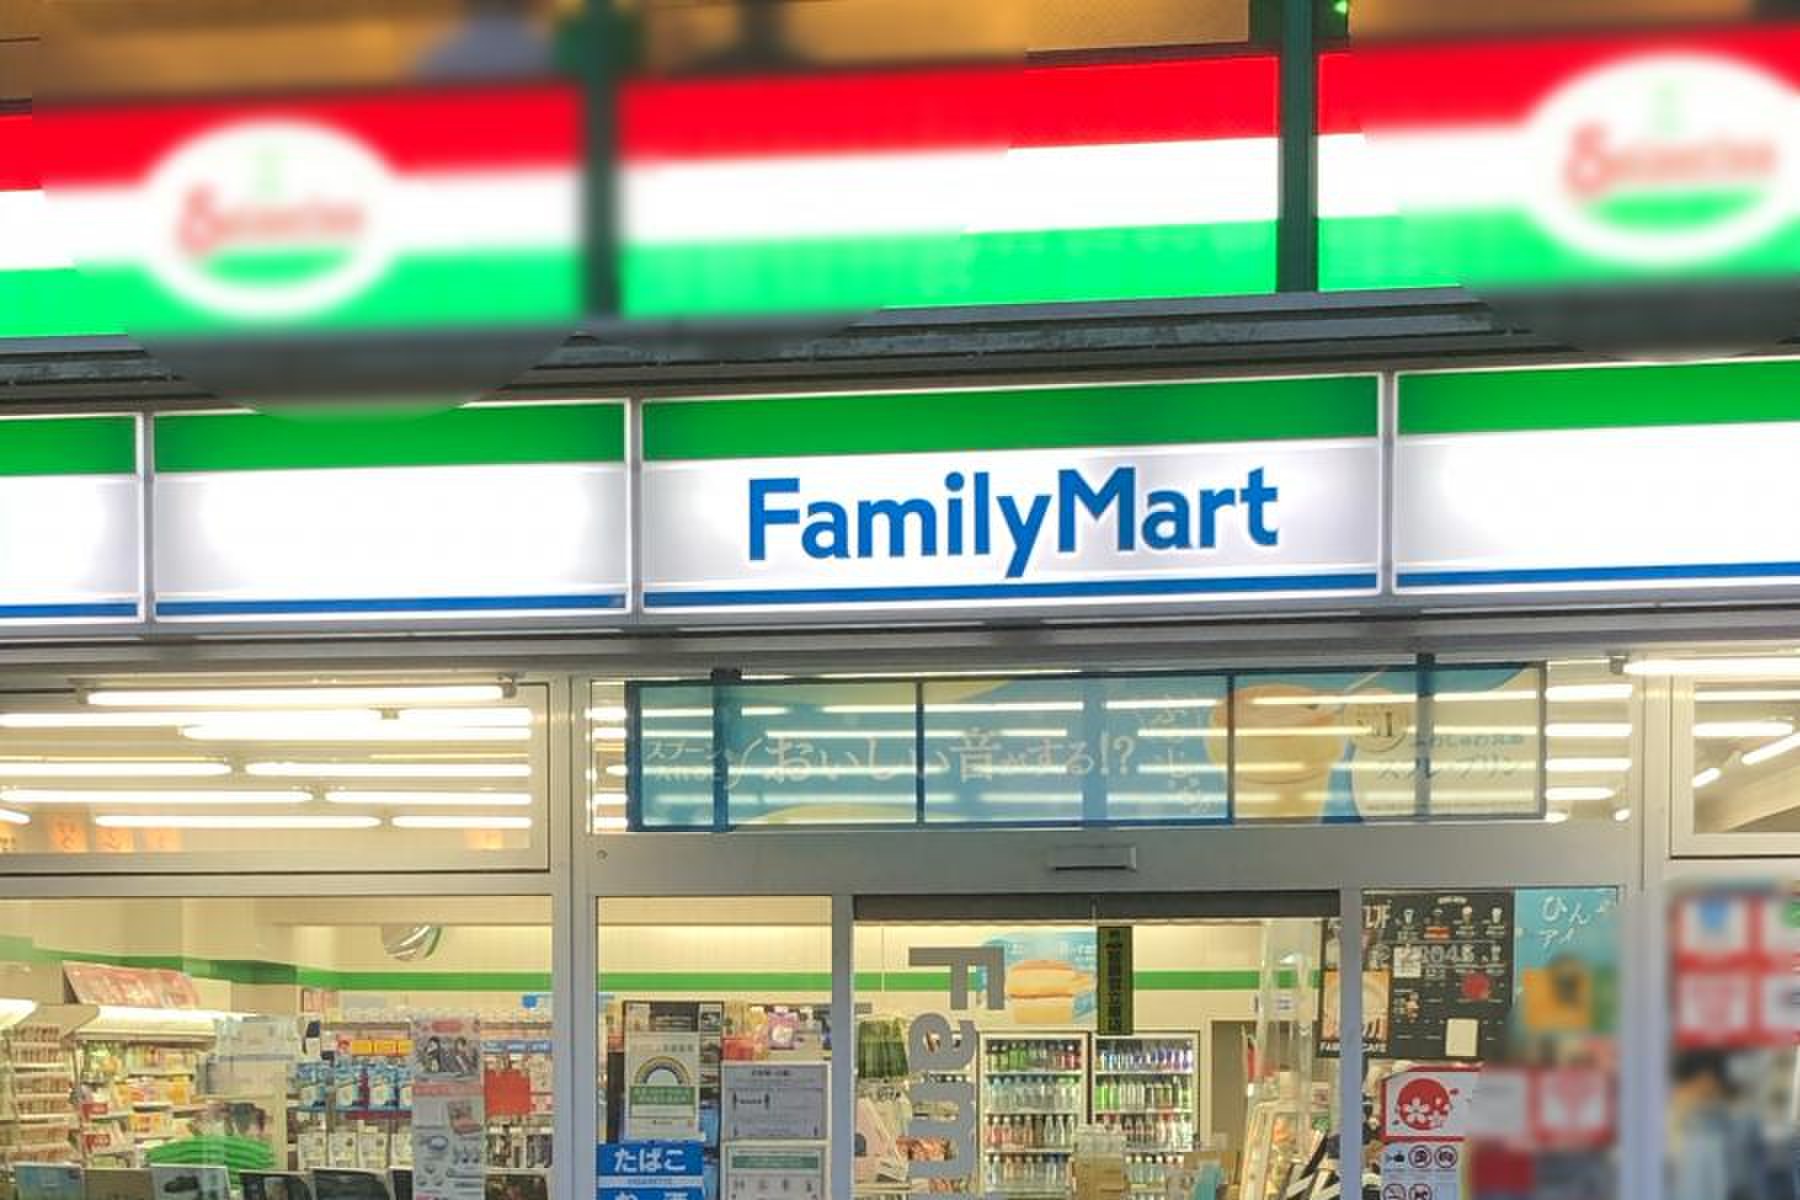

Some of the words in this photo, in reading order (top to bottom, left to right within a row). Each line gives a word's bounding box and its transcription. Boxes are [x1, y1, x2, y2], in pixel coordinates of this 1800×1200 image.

[749, 466, 1279, 579] FamilyMart
[614, 1149, 687, 1173] たばこ
